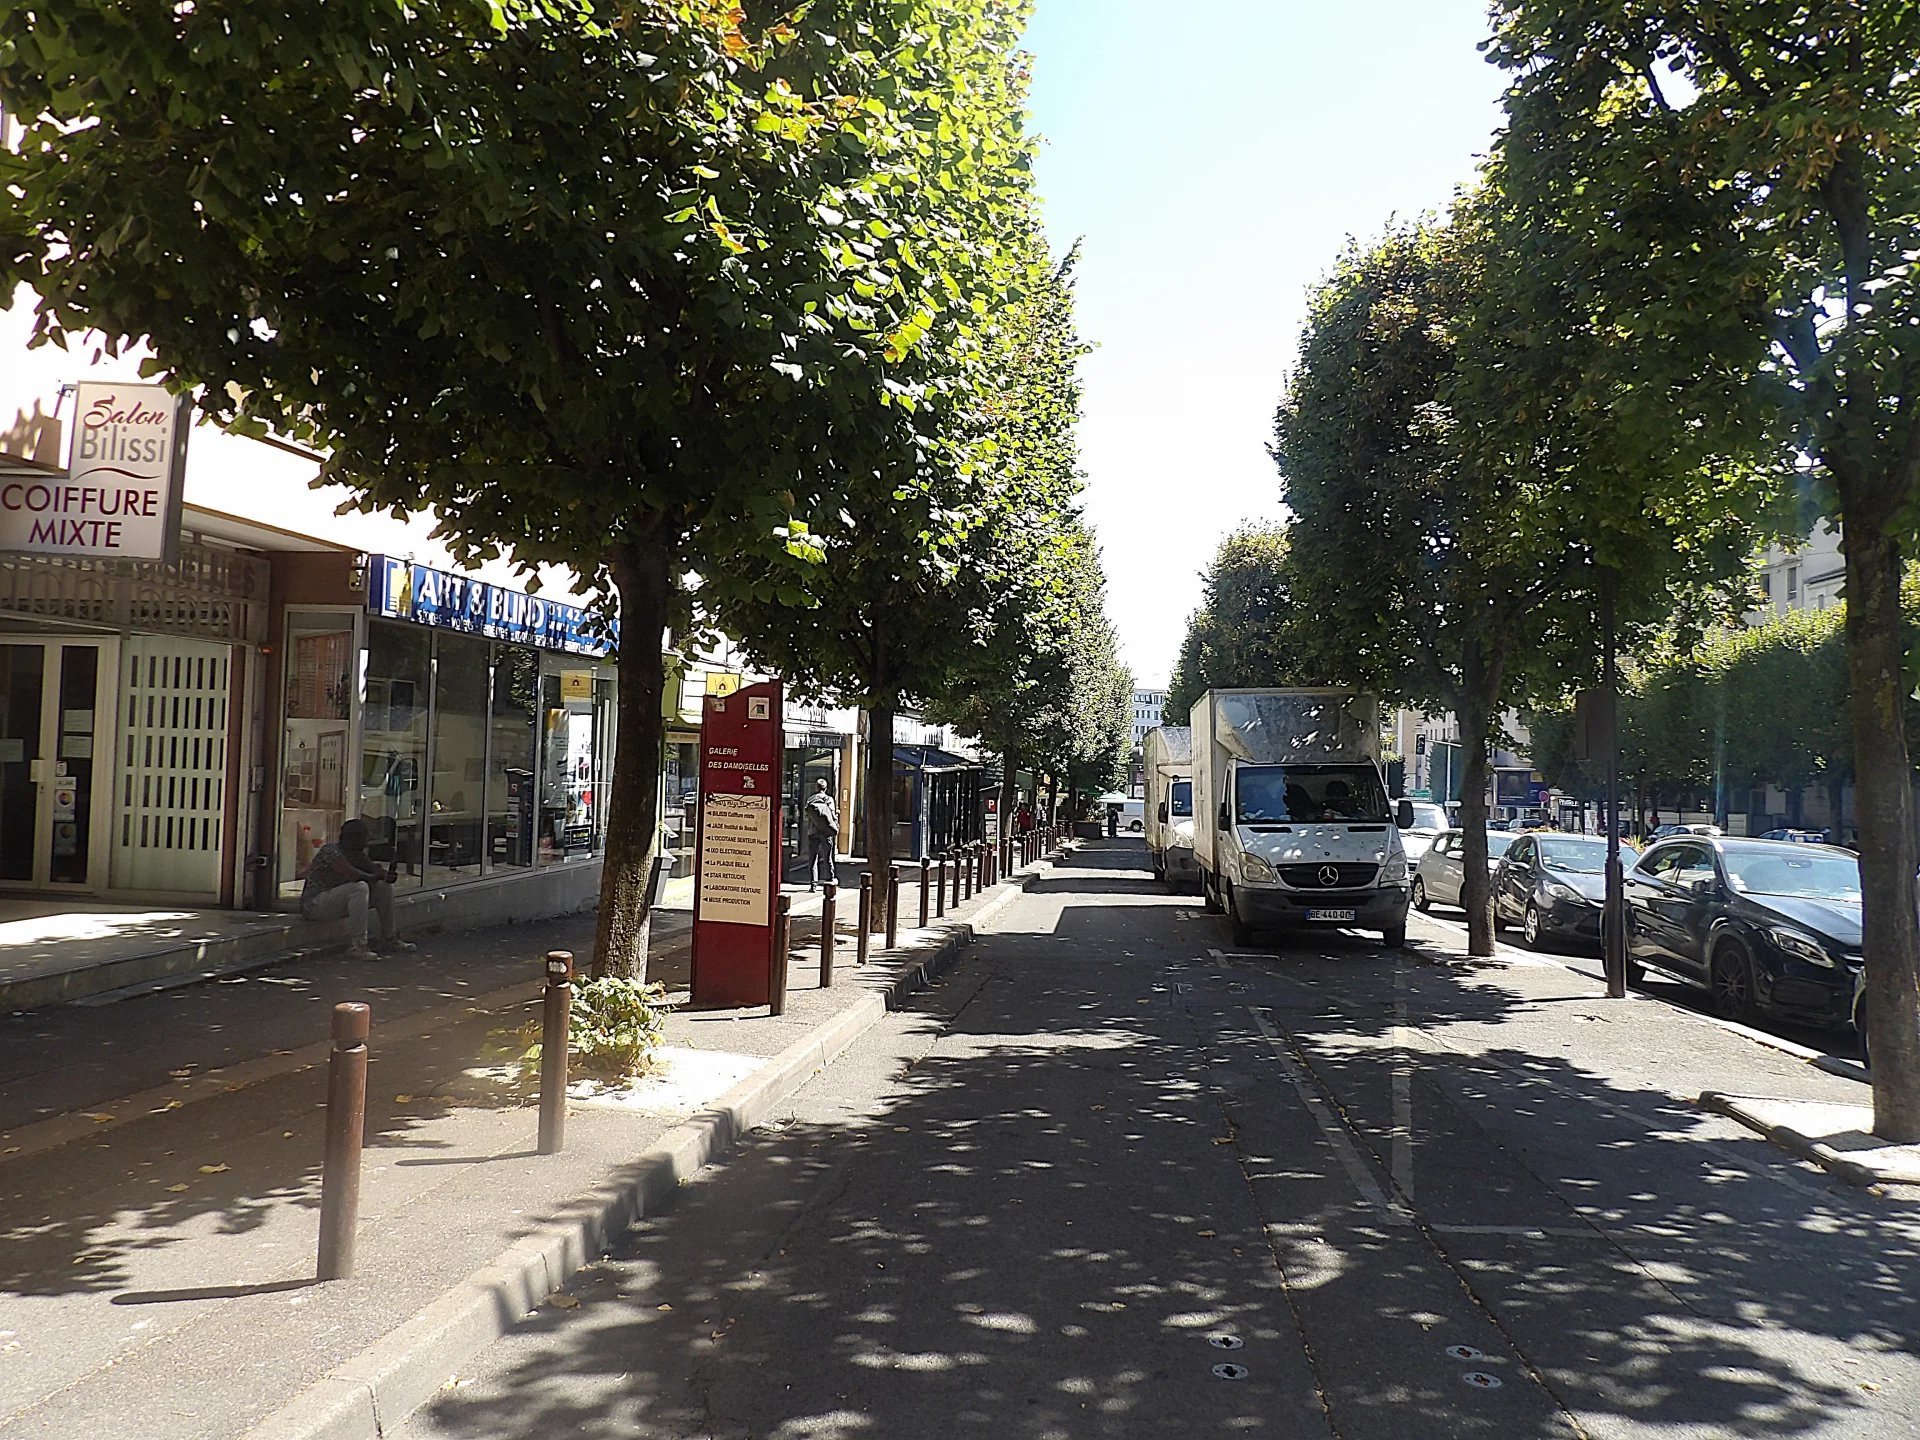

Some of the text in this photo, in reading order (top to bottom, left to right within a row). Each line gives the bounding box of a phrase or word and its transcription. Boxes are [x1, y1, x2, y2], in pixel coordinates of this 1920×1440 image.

[83, 395, 168, 429] Salon
[80, 425, 167, 463] Bilissi
[2, 484, 158, 517] COIFFURE
[28, 518, 122, 548] MIXTE
[418, 571, 465, 611] ART
[470, 583, 486, 616] &
[491, 588, 545, 629] BLIND
[708, 747, 738, 756] GALERIE
[708, 761, 769, 771] DES DAMOISELLES
[709, 884, 740, 892] LABORATOIRE
